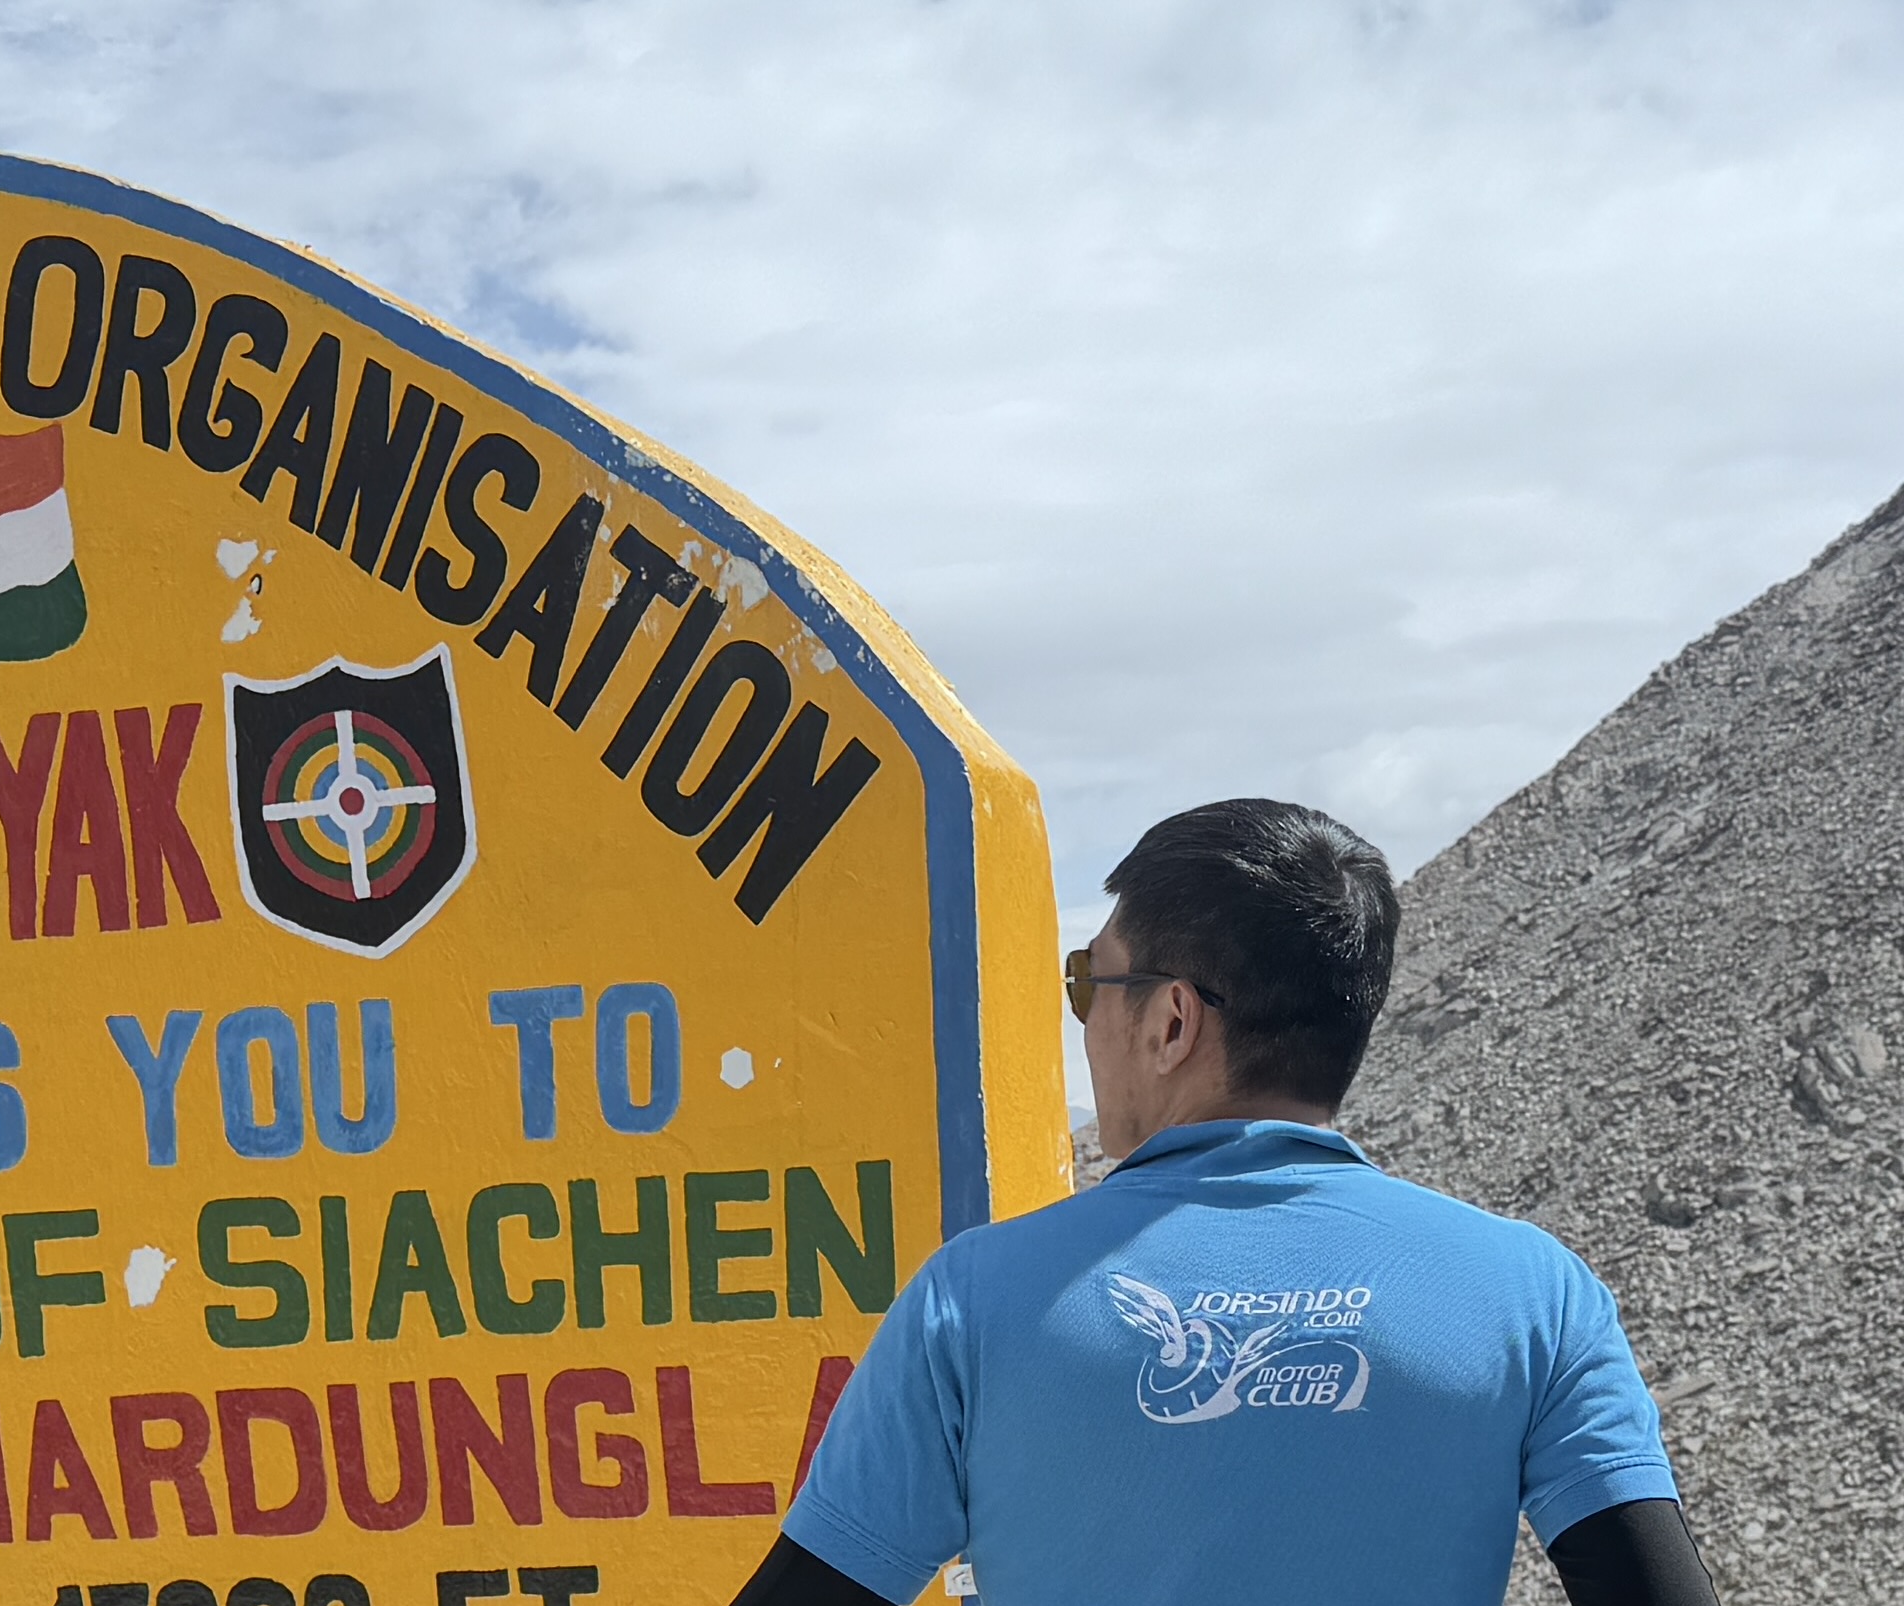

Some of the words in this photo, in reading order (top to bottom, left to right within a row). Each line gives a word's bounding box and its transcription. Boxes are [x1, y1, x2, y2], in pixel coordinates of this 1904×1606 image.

[0, 234, 881, 926] ORGANISATION
[105, 997, 398, 1166] YOU
[488, 981, 683, 1141] TO
[197, 1159, 898, 1349] SIACHEN
[1183, 1287, 1372, 1315] JORSINDO
[1247, 1383, 1342, 1408] CLUB
[1256, 1363, 1343, 1385] MOTOR
